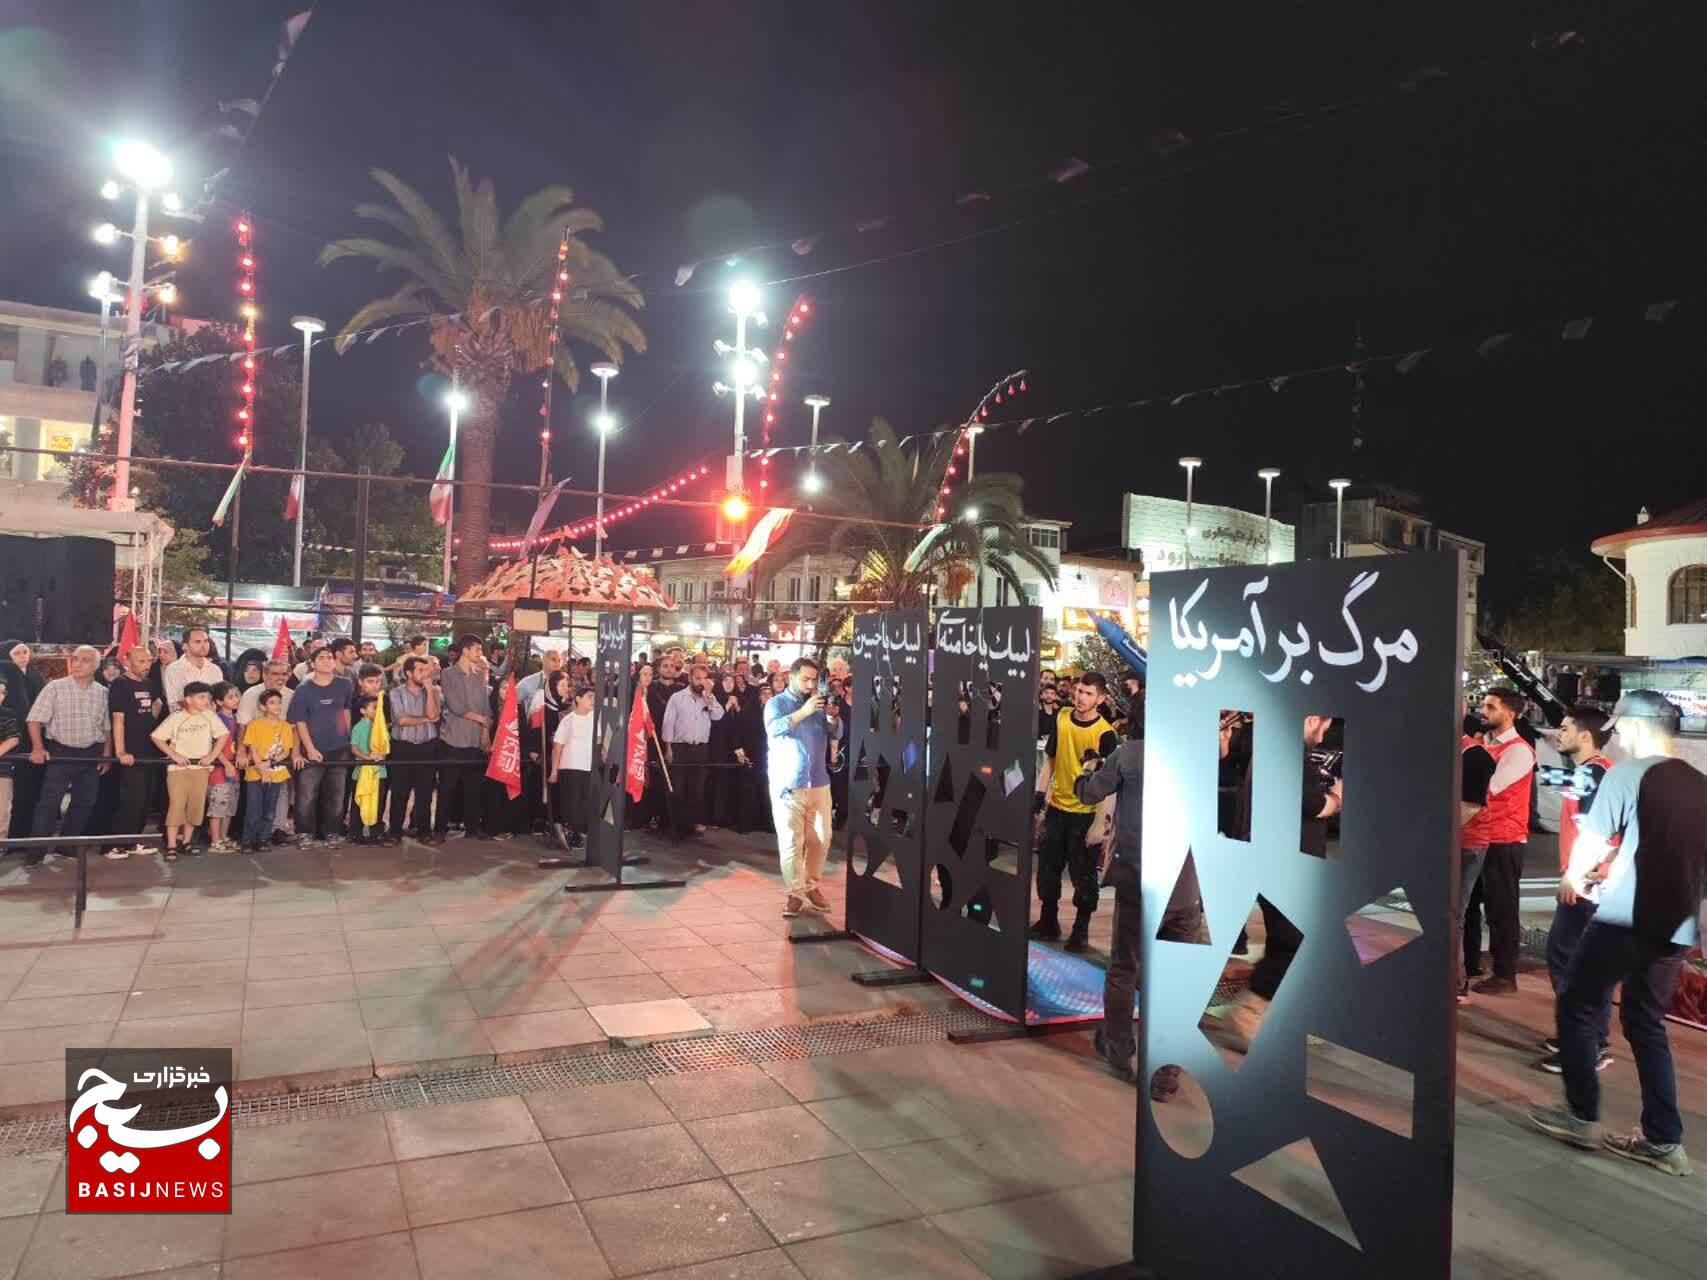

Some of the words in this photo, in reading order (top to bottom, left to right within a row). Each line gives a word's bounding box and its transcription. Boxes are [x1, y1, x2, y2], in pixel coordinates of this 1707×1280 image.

[853, 626, 882, 659] حسین
[881, 621, 891, 662] یا
[977, 622, 989, 672] یا
[1169, 575, 1269, 688] آمریکا
[1258, 621, 1314, 685] بر
[1318, 571, 1419, 693] مرگ
